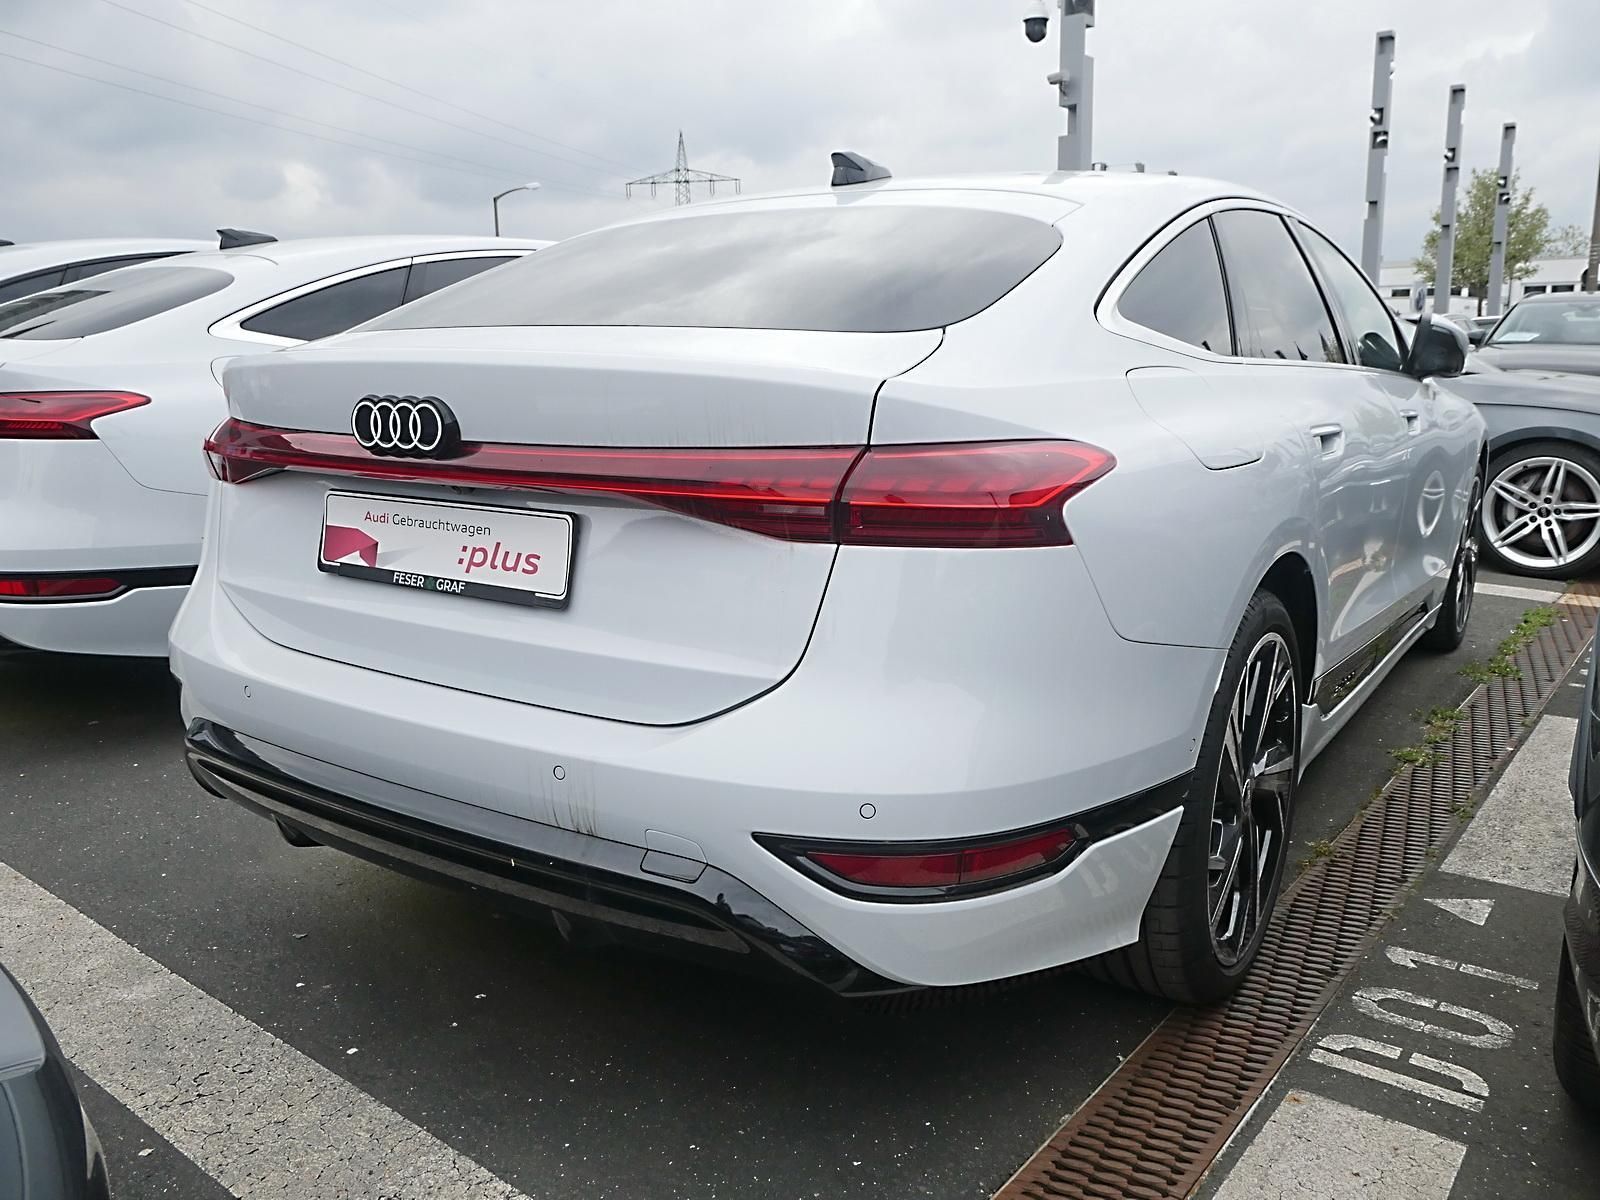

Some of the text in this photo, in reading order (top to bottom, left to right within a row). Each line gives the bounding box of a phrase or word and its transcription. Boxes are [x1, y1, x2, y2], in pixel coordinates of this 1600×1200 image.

[364, 511, 491, 537] Audi Gebrauchtwagen
[393, 572, 466, 593] FESER GRAF
